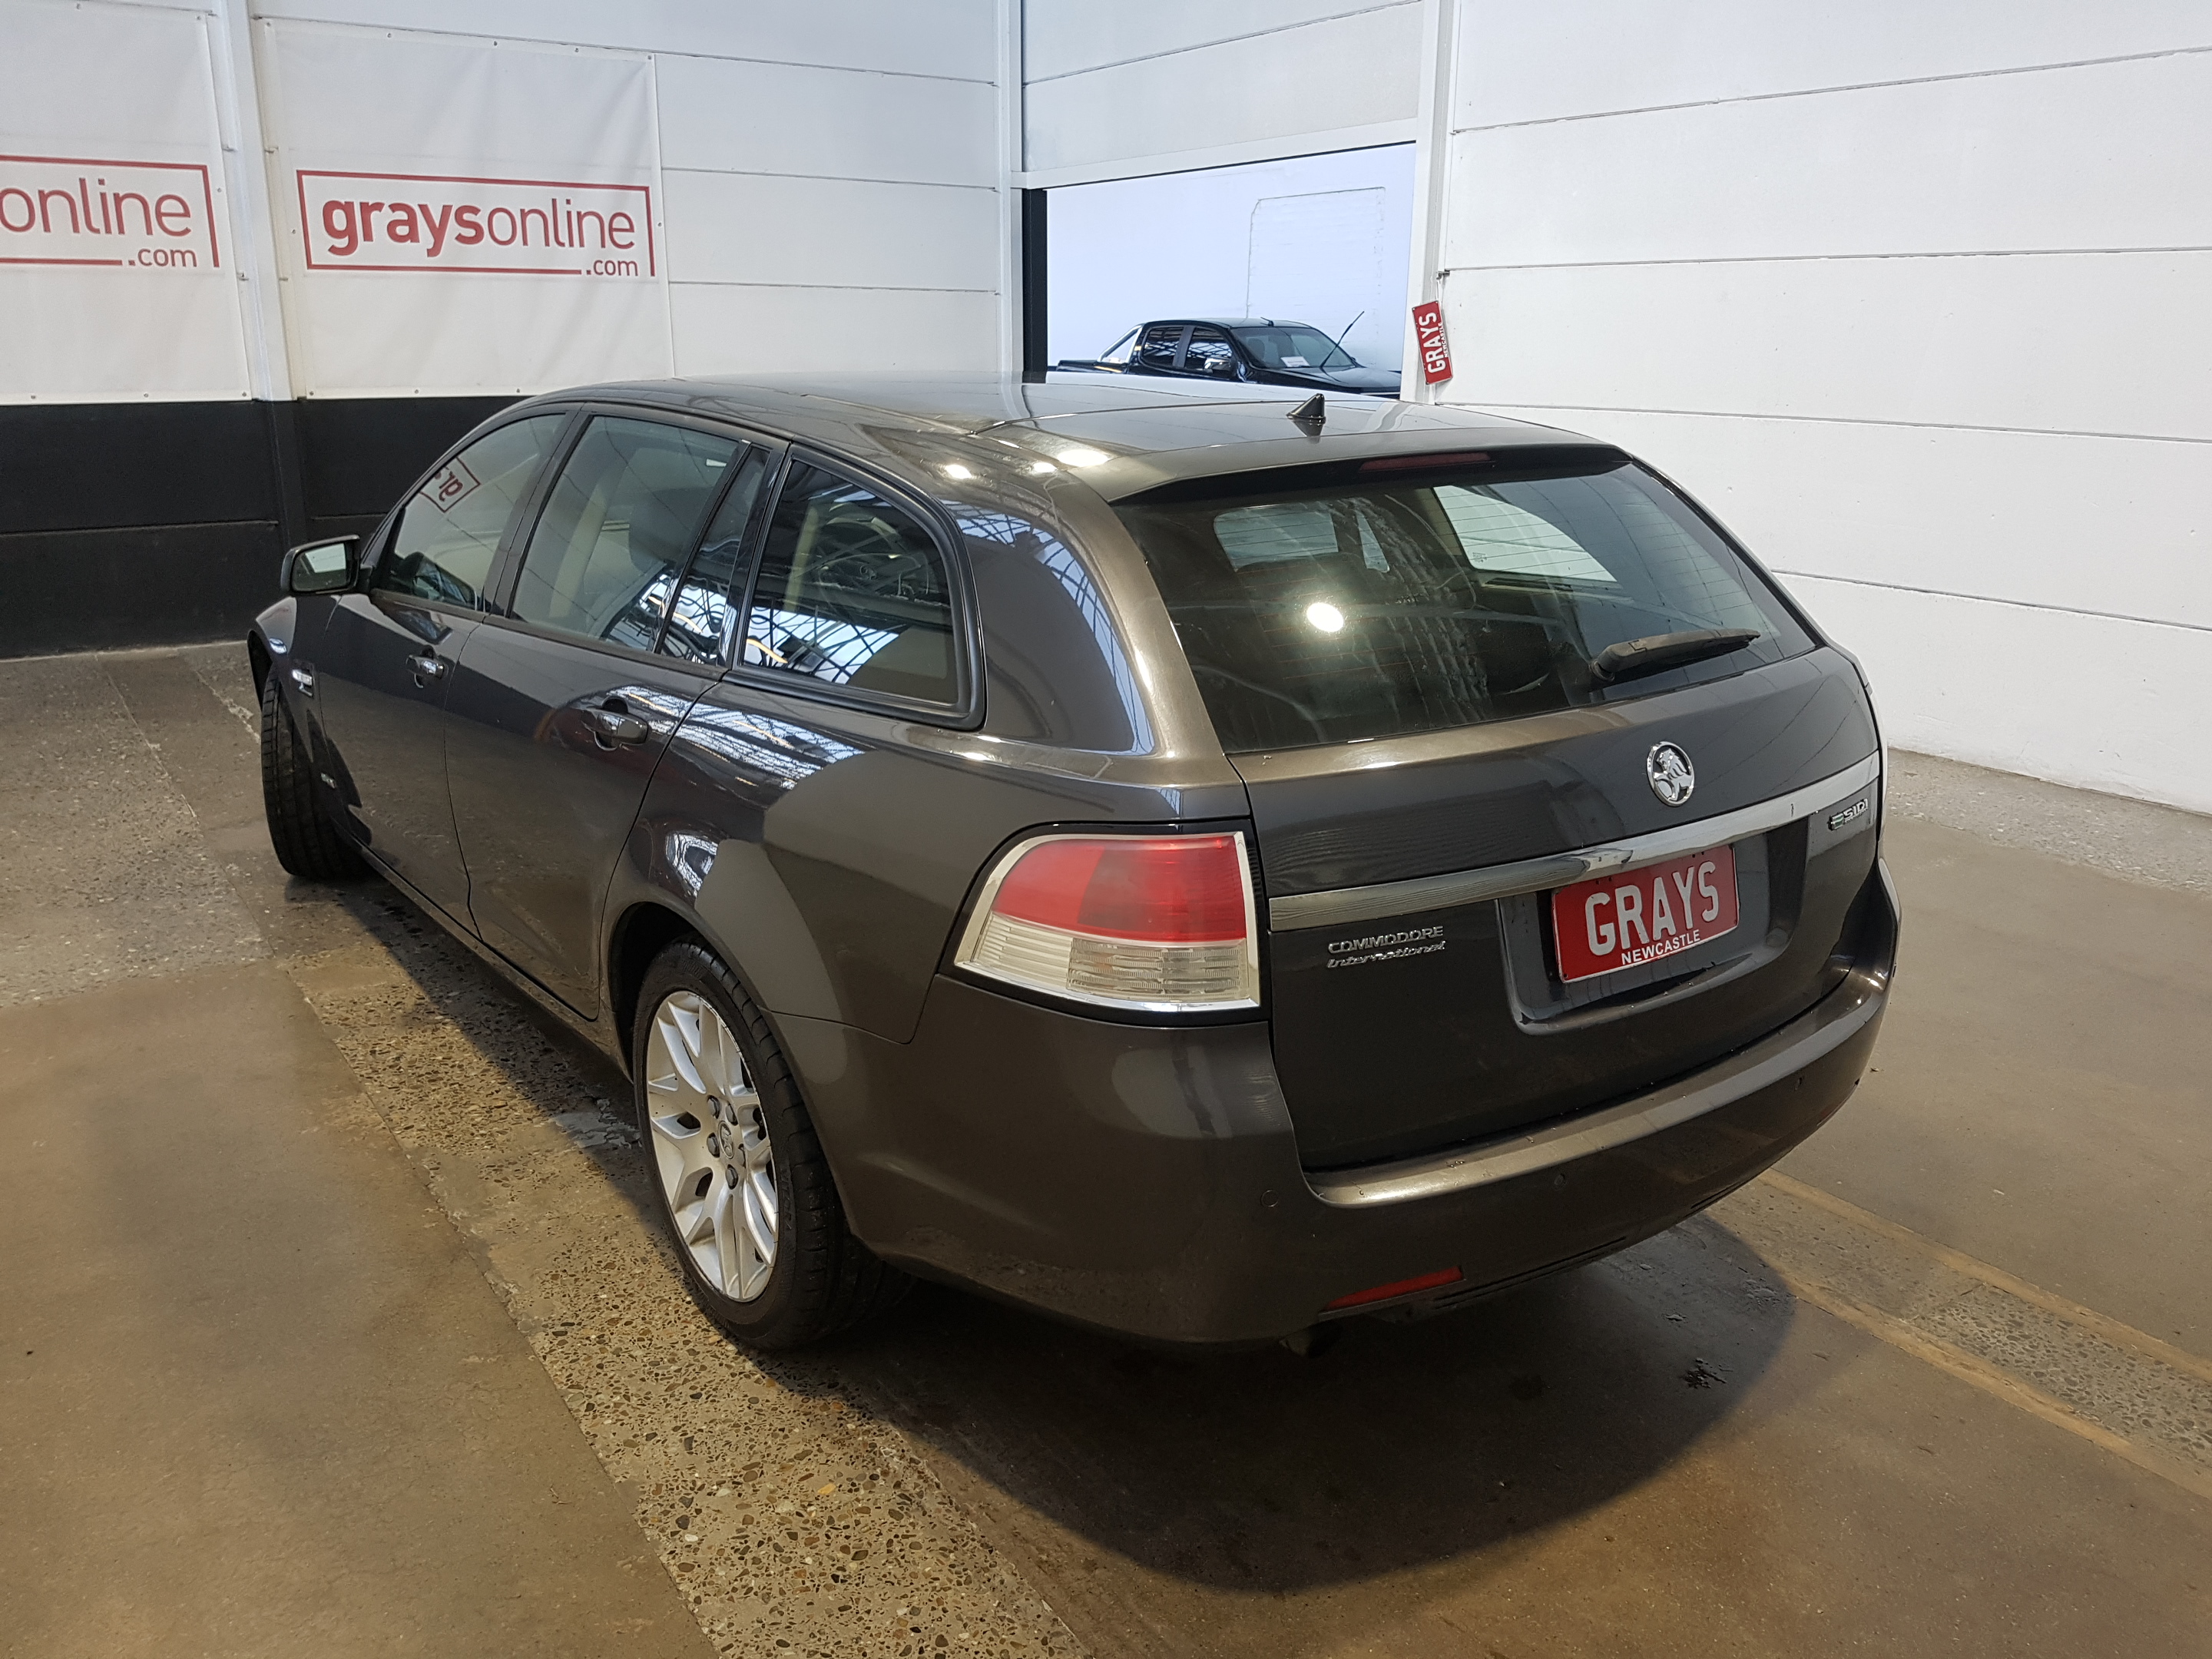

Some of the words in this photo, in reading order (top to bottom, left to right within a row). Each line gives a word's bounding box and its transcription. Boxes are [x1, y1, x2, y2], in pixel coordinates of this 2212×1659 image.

[322, 198, 635, 257] graysonline
[128, 248, 198, 267] .com
[585, 258, 639, 277] .com
[1418, 312, 1446, 373] GRAYS
[1584, 861, 1720, 956] GRAYS
[1326, 940, 1446, 969] International
[1328, 926, 1444, 954] COMMODORE
[1621, 929, 1701, 965] NEWCASTLE
